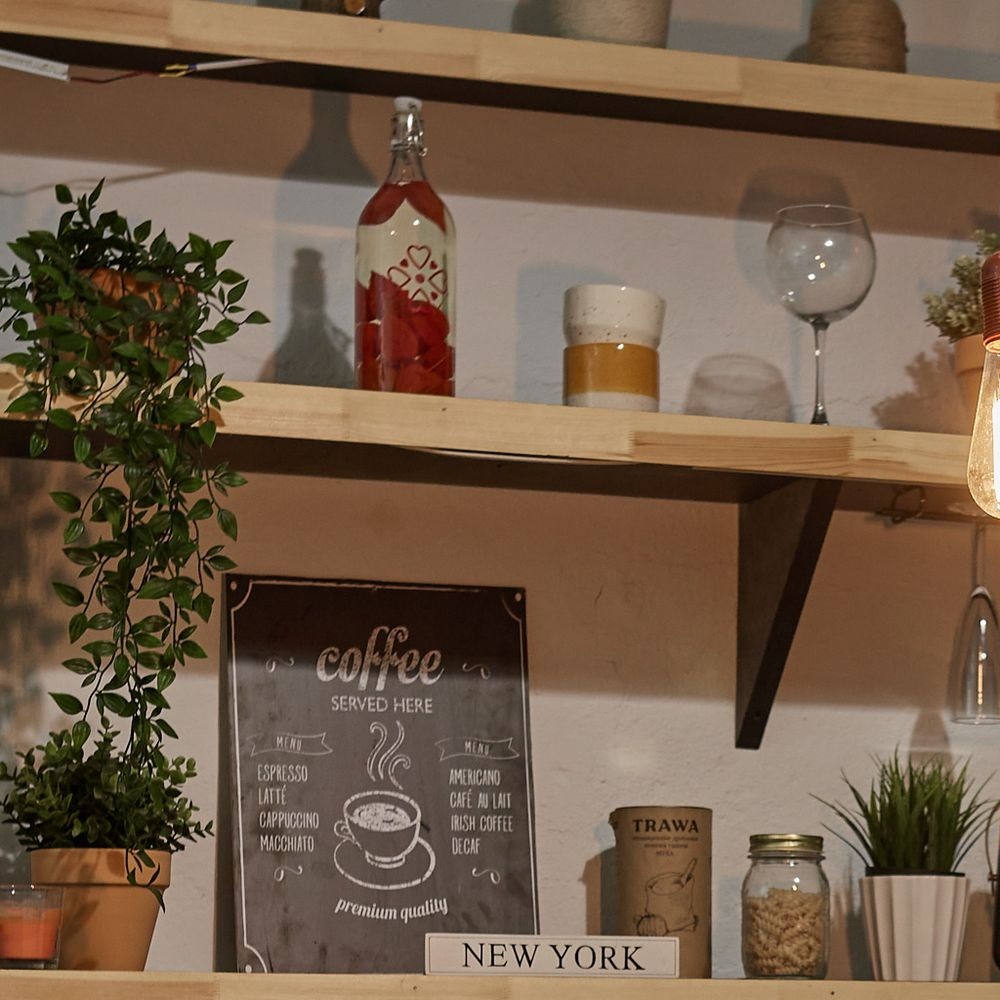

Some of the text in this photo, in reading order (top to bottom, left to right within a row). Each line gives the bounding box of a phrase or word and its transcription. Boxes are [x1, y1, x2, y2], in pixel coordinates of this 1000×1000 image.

[316, 625, 444, 691] coffee
[331, 696, 433, 713] SERVED HERE
[257, 764, 308, 782] ESPRESSO
[449, 768, 501, 786] AMERICANO
[258, 784, 287, 805] LATTÉ
[449, 788, 511, 809] CAFÉ AU LAIT
[259, 811, 320, 829] CAPPUCCINO
[450, 815, 514, 832] IRISH COFFEE
[632, 818, 699, 833] TRAWA
[260, 834, 315, 852] MACCHIATO
[451, 837, 480, 855] DECAF
[334, 897, 448, 925] premium quality
[462, 942, 646, 971] NEW YORK
